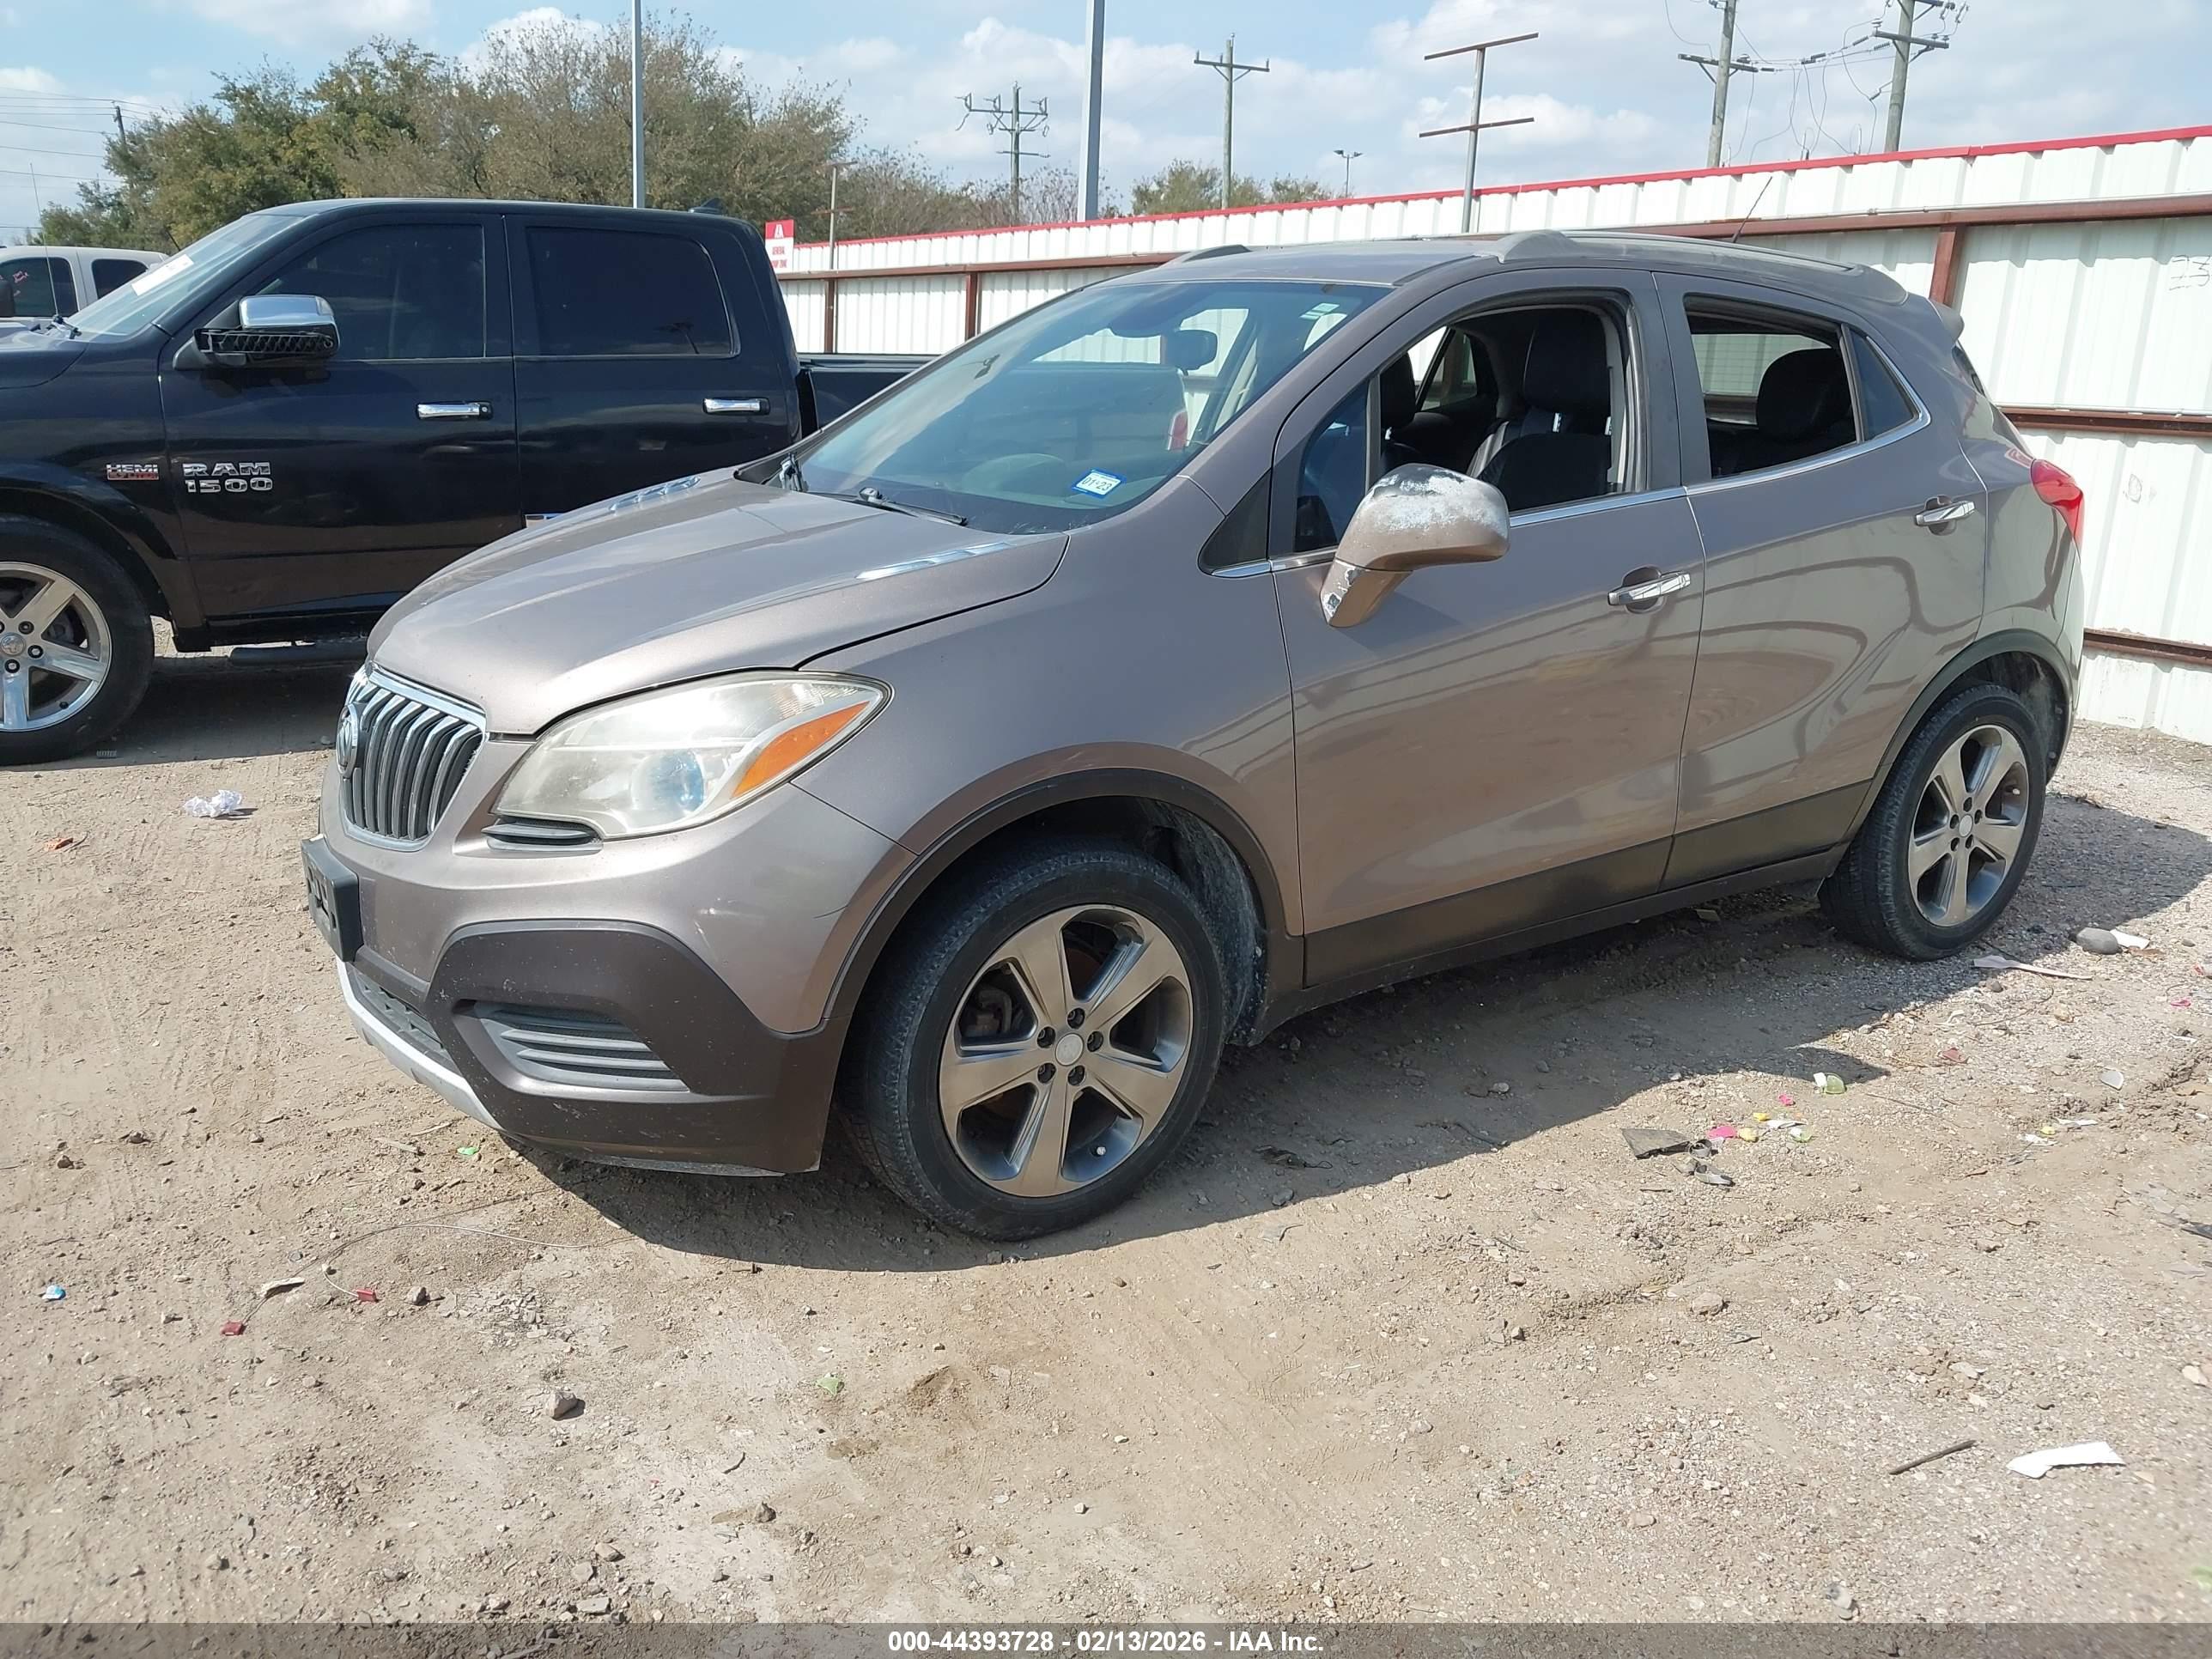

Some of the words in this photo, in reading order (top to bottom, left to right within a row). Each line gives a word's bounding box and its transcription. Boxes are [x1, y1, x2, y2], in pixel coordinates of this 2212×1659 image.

[106, 465, 159, 473] HEMI
[182, 462, 271, 477] RAM
[185, 477, 273, 493] 1500
